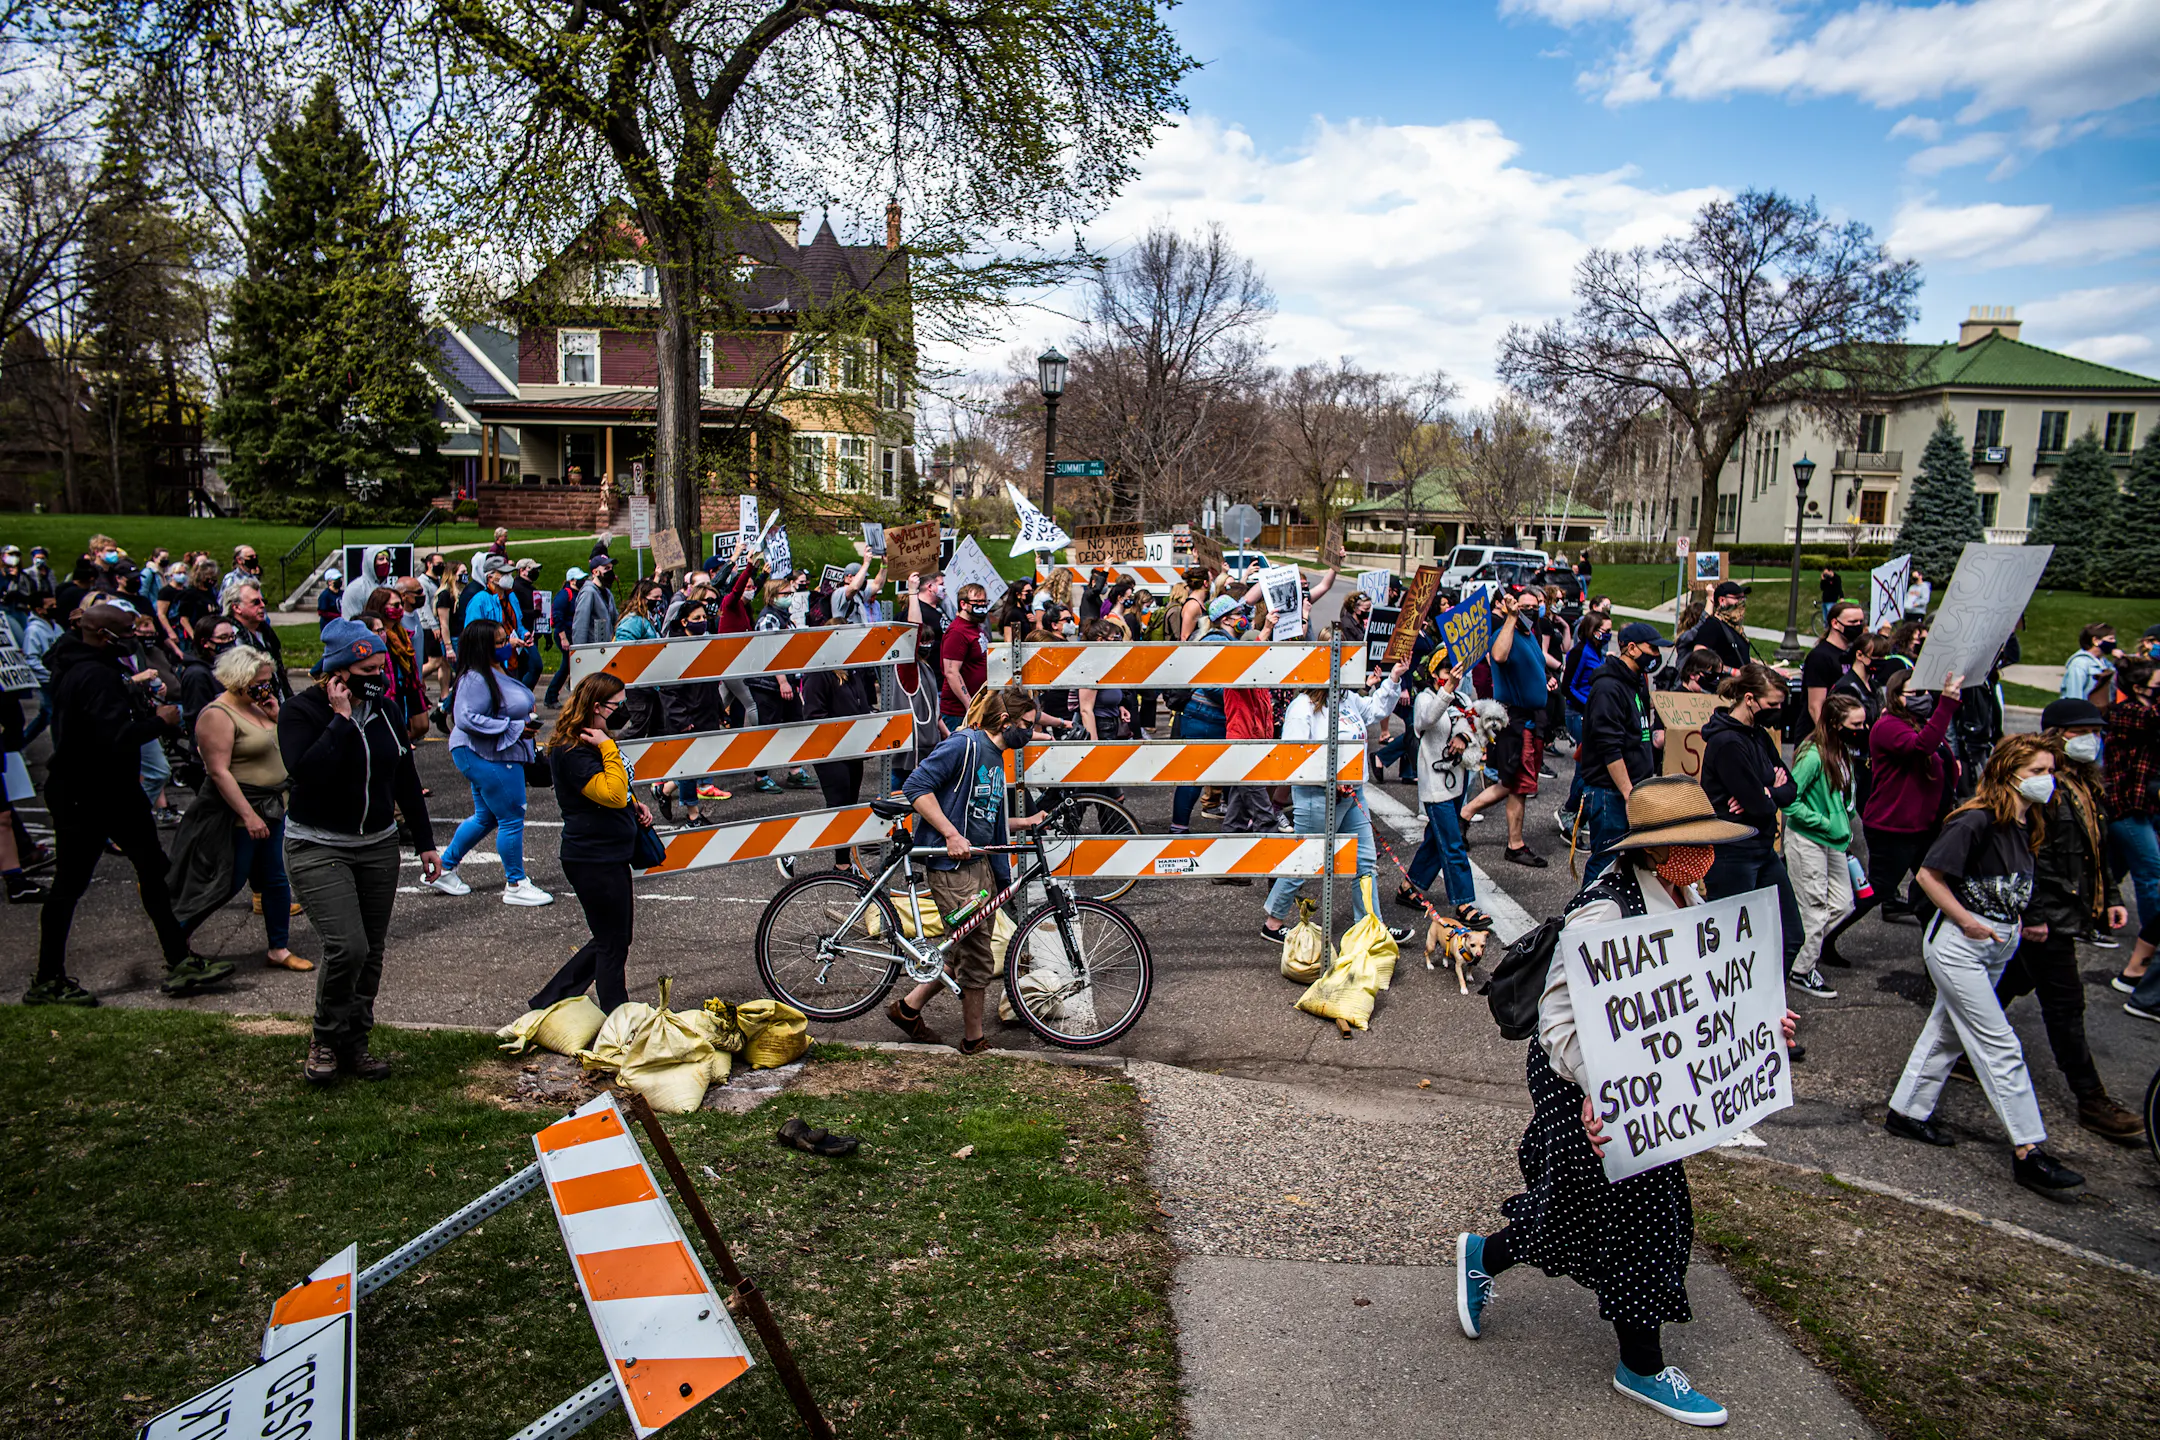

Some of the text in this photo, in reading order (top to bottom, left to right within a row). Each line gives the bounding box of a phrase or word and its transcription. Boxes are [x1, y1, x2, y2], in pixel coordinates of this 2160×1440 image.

[1056, 463, 1085, 474] SUMMIT
[889, 522, 937, 545] WHITE
[1081, 527, 1101, 540] FIX
[1087, 537, 1138, 550] NO MORE
[898, 540, 931, 556] People
[1078, 547, 1144, 564] DEADLY FORCE
[890, 556, 907, 569] Time
[964, 540, 1004, 596] JUSTICE
[1359, 569, 1388, 590] JUSTICE
[1951, 550, 2048, 602] STOP
[1369, 621, 1387, 635] BLACK
[1444, 596, 1487, 644] BLACK
[1371, 644, 1387, 657] MATT
[1656, 695, 1674, 708] GOV
[1665, 710, 1696, 725] WALZ
[952, 886, 1011, 943] SPECIALIZED
[1579, 906, 1752, 987] WHAT IS A
[1605, 951, 1756, 1042] POLITE WAY
[1641, 1001, 1736, 1064] TO SAY
[1600, 1021, 1776, 1124] STOP KILLING
[1624, 1051, 1782, 1158] BLACK PEOPLE?
